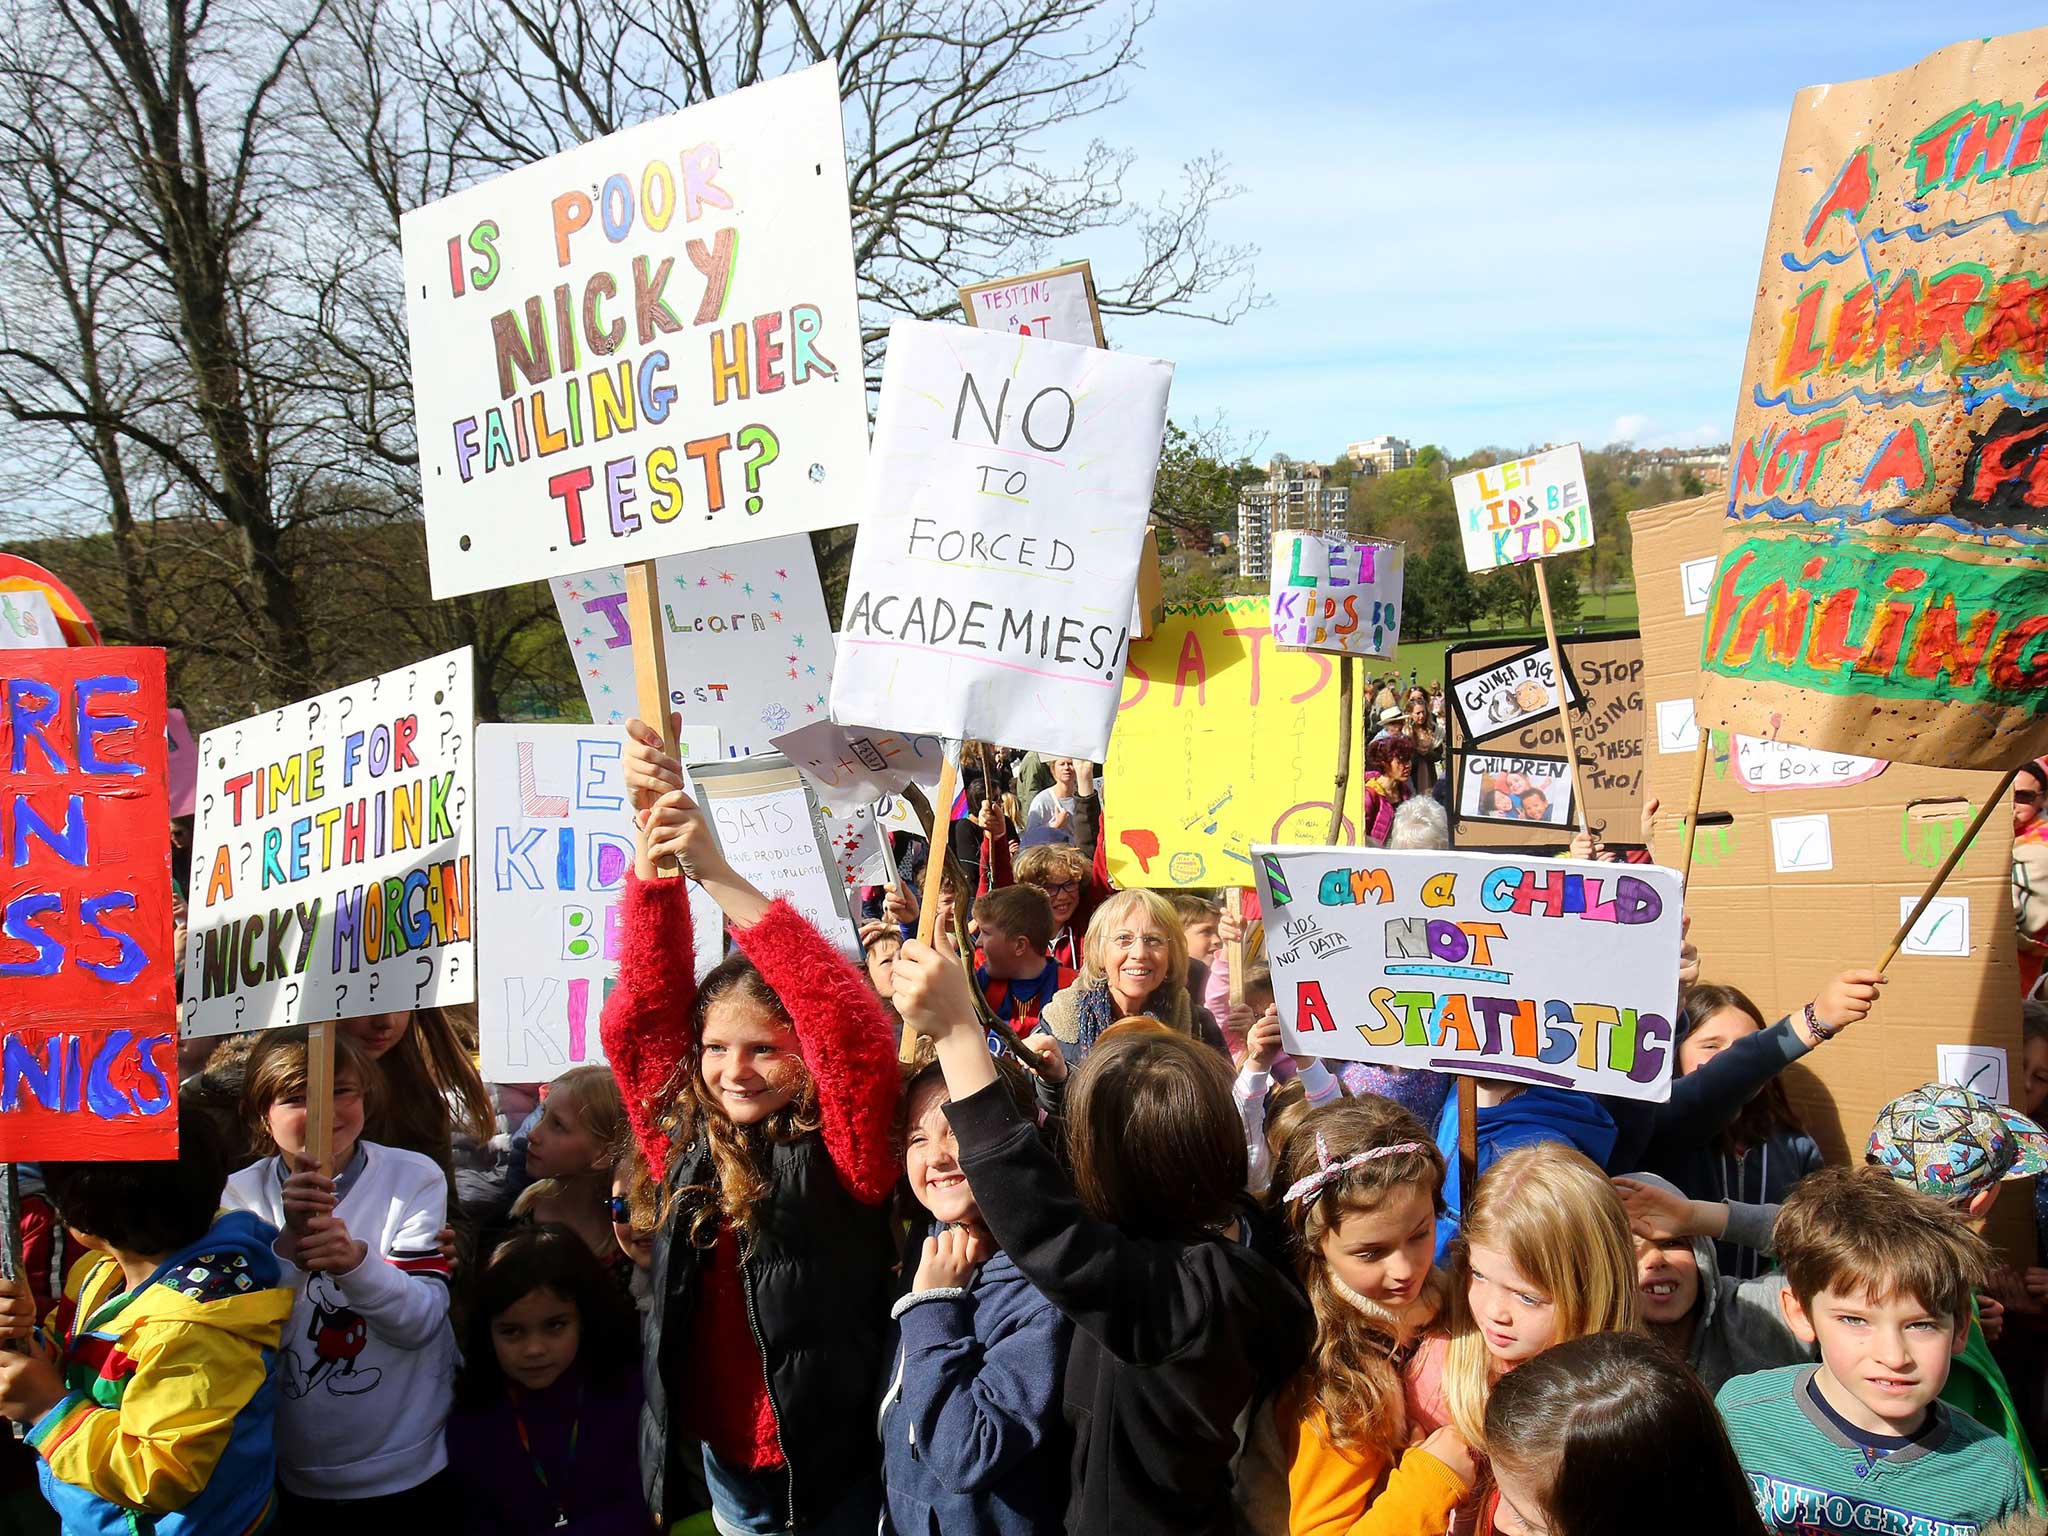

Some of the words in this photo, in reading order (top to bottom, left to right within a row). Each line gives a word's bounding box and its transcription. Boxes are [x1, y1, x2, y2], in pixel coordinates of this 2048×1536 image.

[447, 220, 500, 297] IS
[551, 142, 734, 267] POOR
[1802, 144, 1878, 249] A
[491, 227, 740, 400] NICKY
[982, 280, 1050, 310] TESTING
[452, 350, 678, 483] FAILING
[710, 304, 837, 405] HER
[952, 373, 1077, 452] NO
[548, 423, 780, 546] TEST?
[977, 466, 1028, 494] TO
[1476, 458, 1536, 500] LET
[1728, 409, 1848, 517] NOT
[1857, 418, 1935, 498] A
[1547, 481, 1582, 511] BE
[908, 518, 1075, 571] FORCED
[1288, 538, 1380, 588] LET
[665, 604, 766, 633] Learn
[845, 592, 1126, 681] ACADEMIES!
[670, 684, 729, 705] esT
[1465, 665, 1519, 711] GUINEA
[1581, 659, 1643, 686] STOP
[6, 675, 146, 778] RE
[1519, 692, 1643, 749] CONFUSING
[224, 745, 325, 827] TIME
[344, 714, 419, 787] FOR
[1469, 757, 1567, 778] CHILDREN
[1594, 739, 1643, 761] THESE
[1741, 743, 1750, 755] A
[1780, 758, 1820, 780] BOX
[517, 740, 640, 817] LE
[1587, 770, 1642, 795] TWO!
[206, 844, 233, 907] A
[262, 771, 455, 890] RETHINK
[716, 801, 793, 844] SATS
[495, 826, 640, 892] KID
[753, 844, 812, 861] PRODUCED
[1262, 853, 1293, 909] I
[1318, 867, 1394, 906] am
[1420, 872, 1458, 908] a
[1480, 865, 1663, 924] CHILD
[202, 898, 322, 1001] NICKY
[332, 855, 471, 974] MORGAN
[1275, 947, 1301, 968] NOT
[1309, 931, 1349, 956] DATA
[1282, 914, 1318, 940] KIDS
[1384, 917, 1508, 966] NOT
[505, 977, 617, 1066] KI
[1295, 981, 1337, 1032] A
[1356, 986, 1672, 1083] STATISTIC
